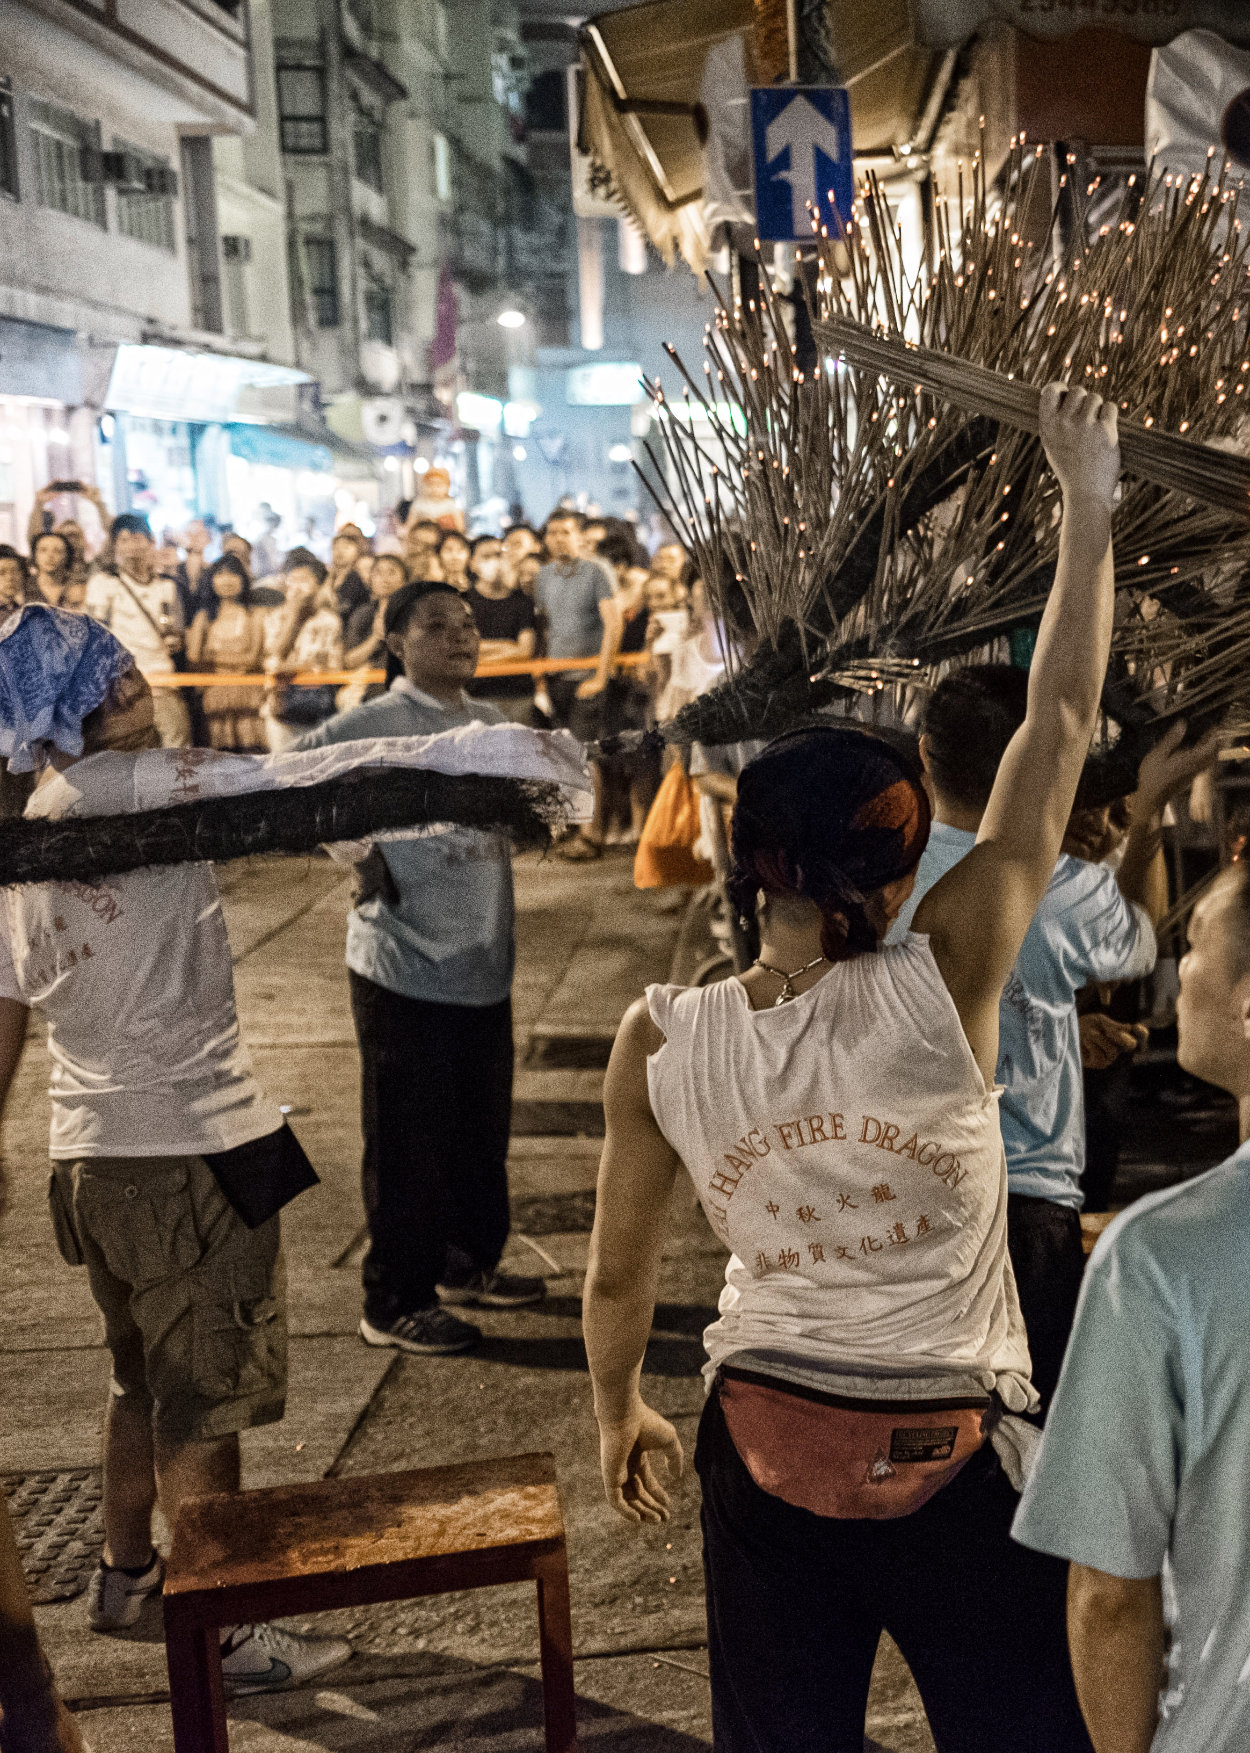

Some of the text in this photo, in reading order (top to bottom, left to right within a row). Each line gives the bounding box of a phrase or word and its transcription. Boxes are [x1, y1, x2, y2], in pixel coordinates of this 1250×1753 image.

[709, 1127, 771, 1200] HANG
[774, 1113, 847, 1150] FIRE
[858, 1115, 969, 1189] DRAGON
[765, 1183, 896, 1223] 中秋火龍
